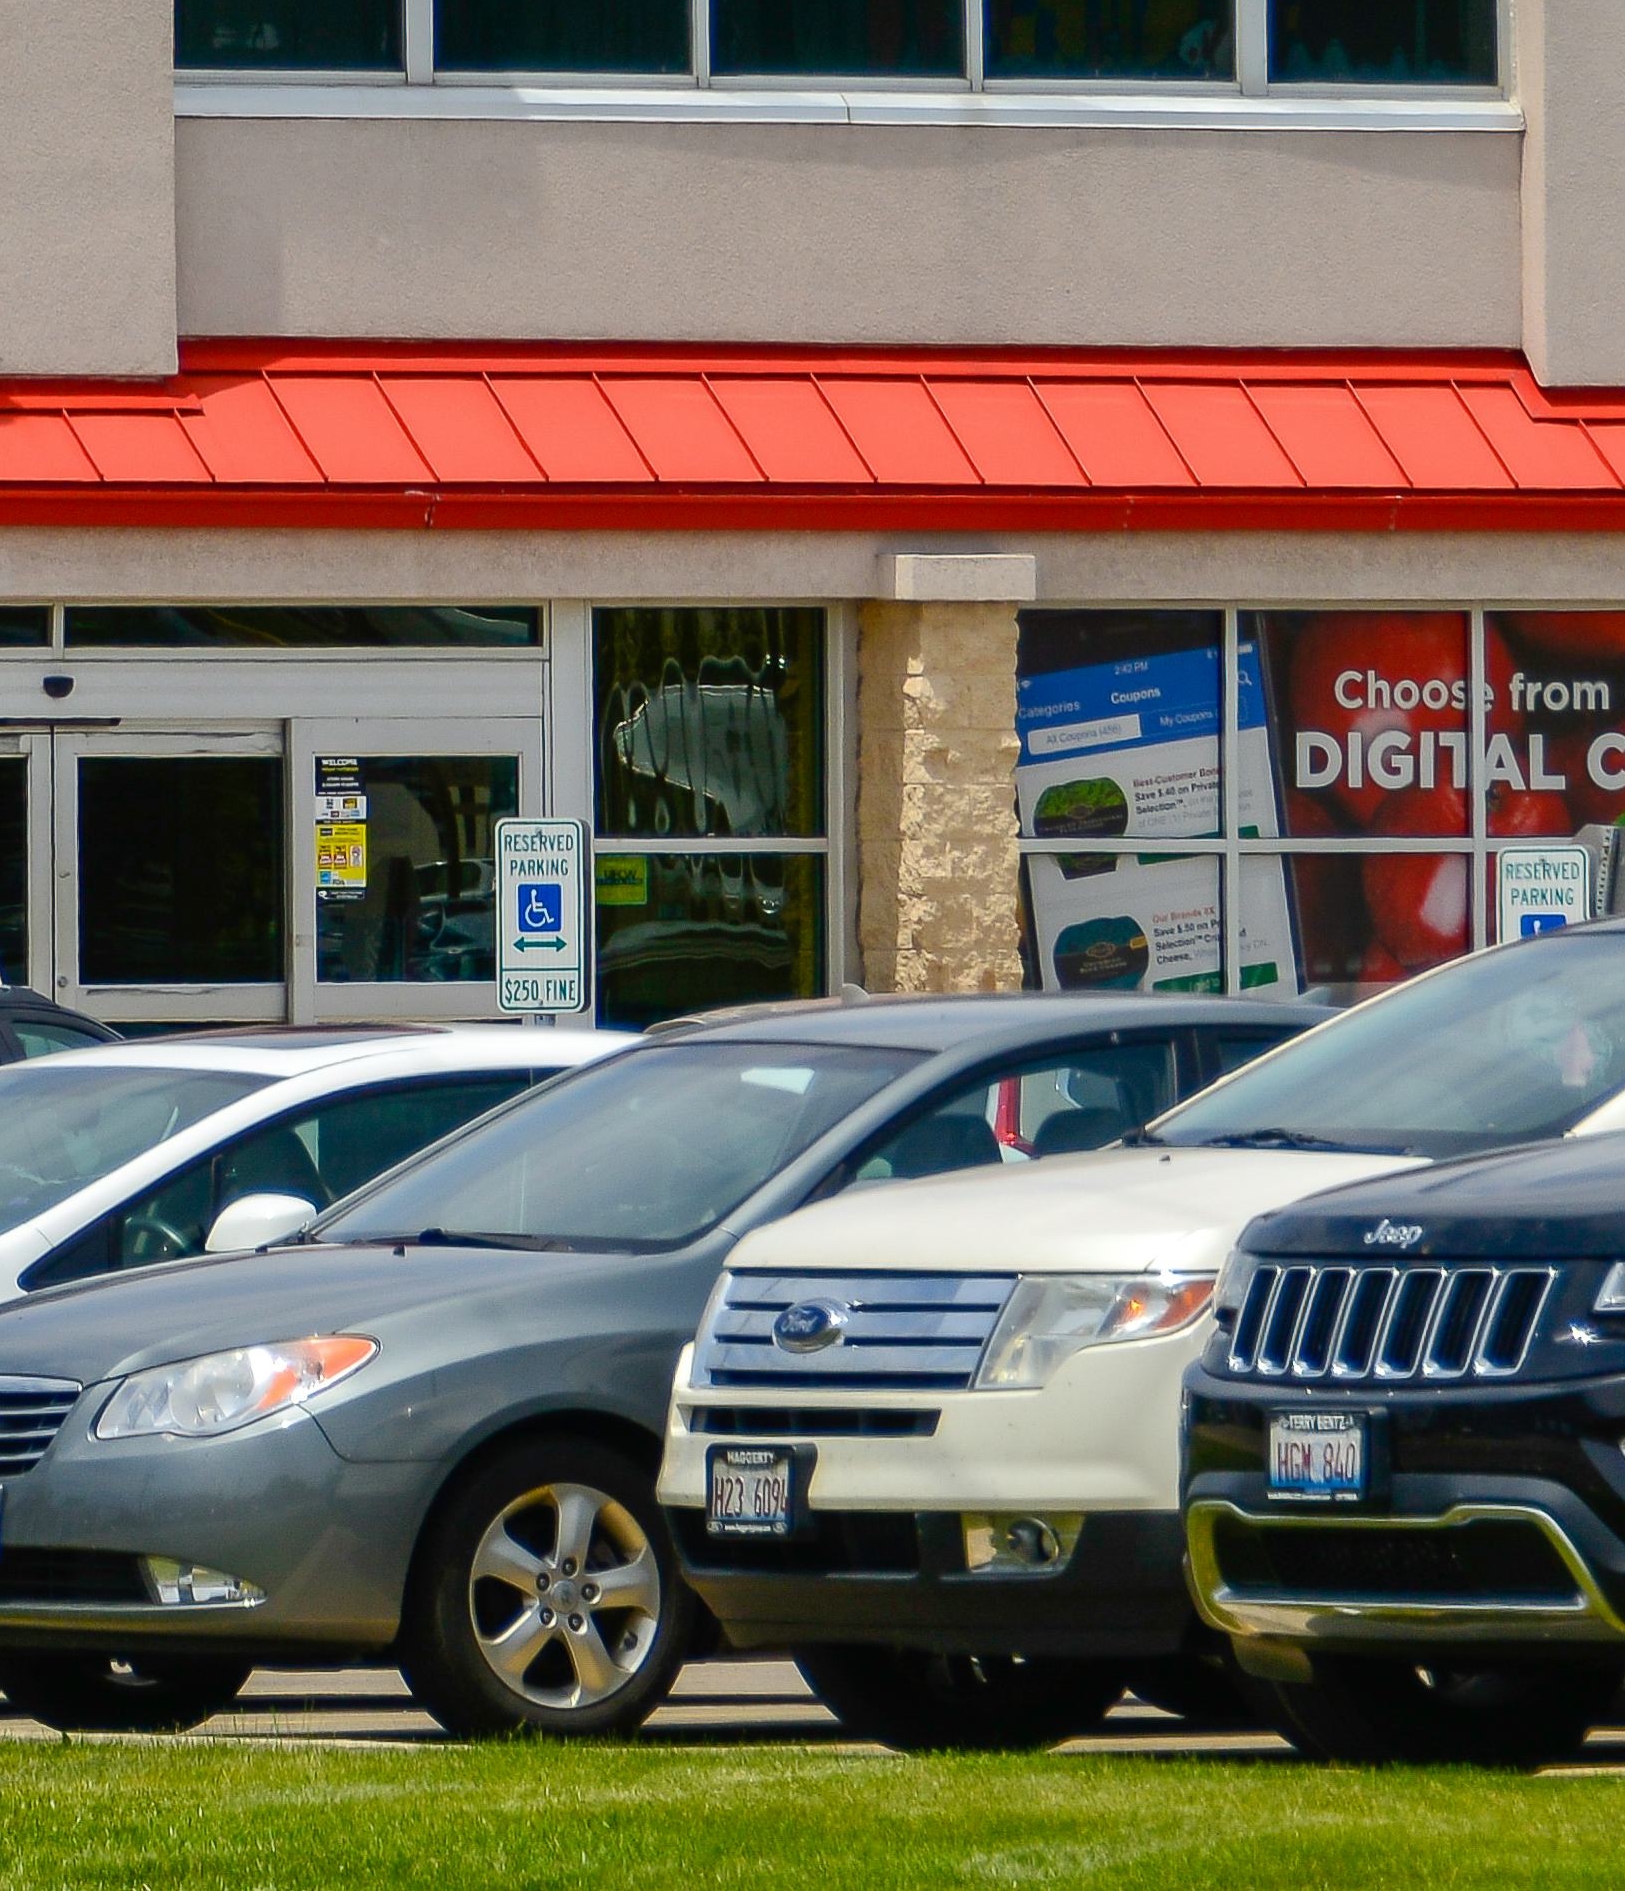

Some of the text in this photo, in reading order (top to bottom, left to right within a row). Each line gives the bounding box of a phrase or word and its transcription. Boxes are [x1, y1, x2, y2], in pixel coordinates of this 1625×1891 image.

[1111, 688, 1161, 704] Coupons
[1509, 672, 1609, 711] from
[1019, 701, 1080, 718] Categories
[1160, 711, 1213, 727] My Coupons
[1059, 729, 1097, 743] Coupons
[1296, 730, 1566, 790] DIGITAL
[1135, 791, 1156, 802] Save
[1177, 786, 1189, 795] on
[504, 834, 574, 852] RESERVED
[510, 859, 569, 876] PARKING
[1505, 861, 1580, 880] RESERVED
[1511, 888, 1574, 906] PARKING
[1154, 927, 1175, 937] Save
[1197, 922, 1209, 930] on
[505, 977, 576, 1004] $250 FINE
[1363, 1218, 1423, 1249] Jeep
[727, 1450, 775, 1464] HAGGERTY
[1323, 1440, 1356, 1483] 840
[714, 1477, 744, 1517] H23
